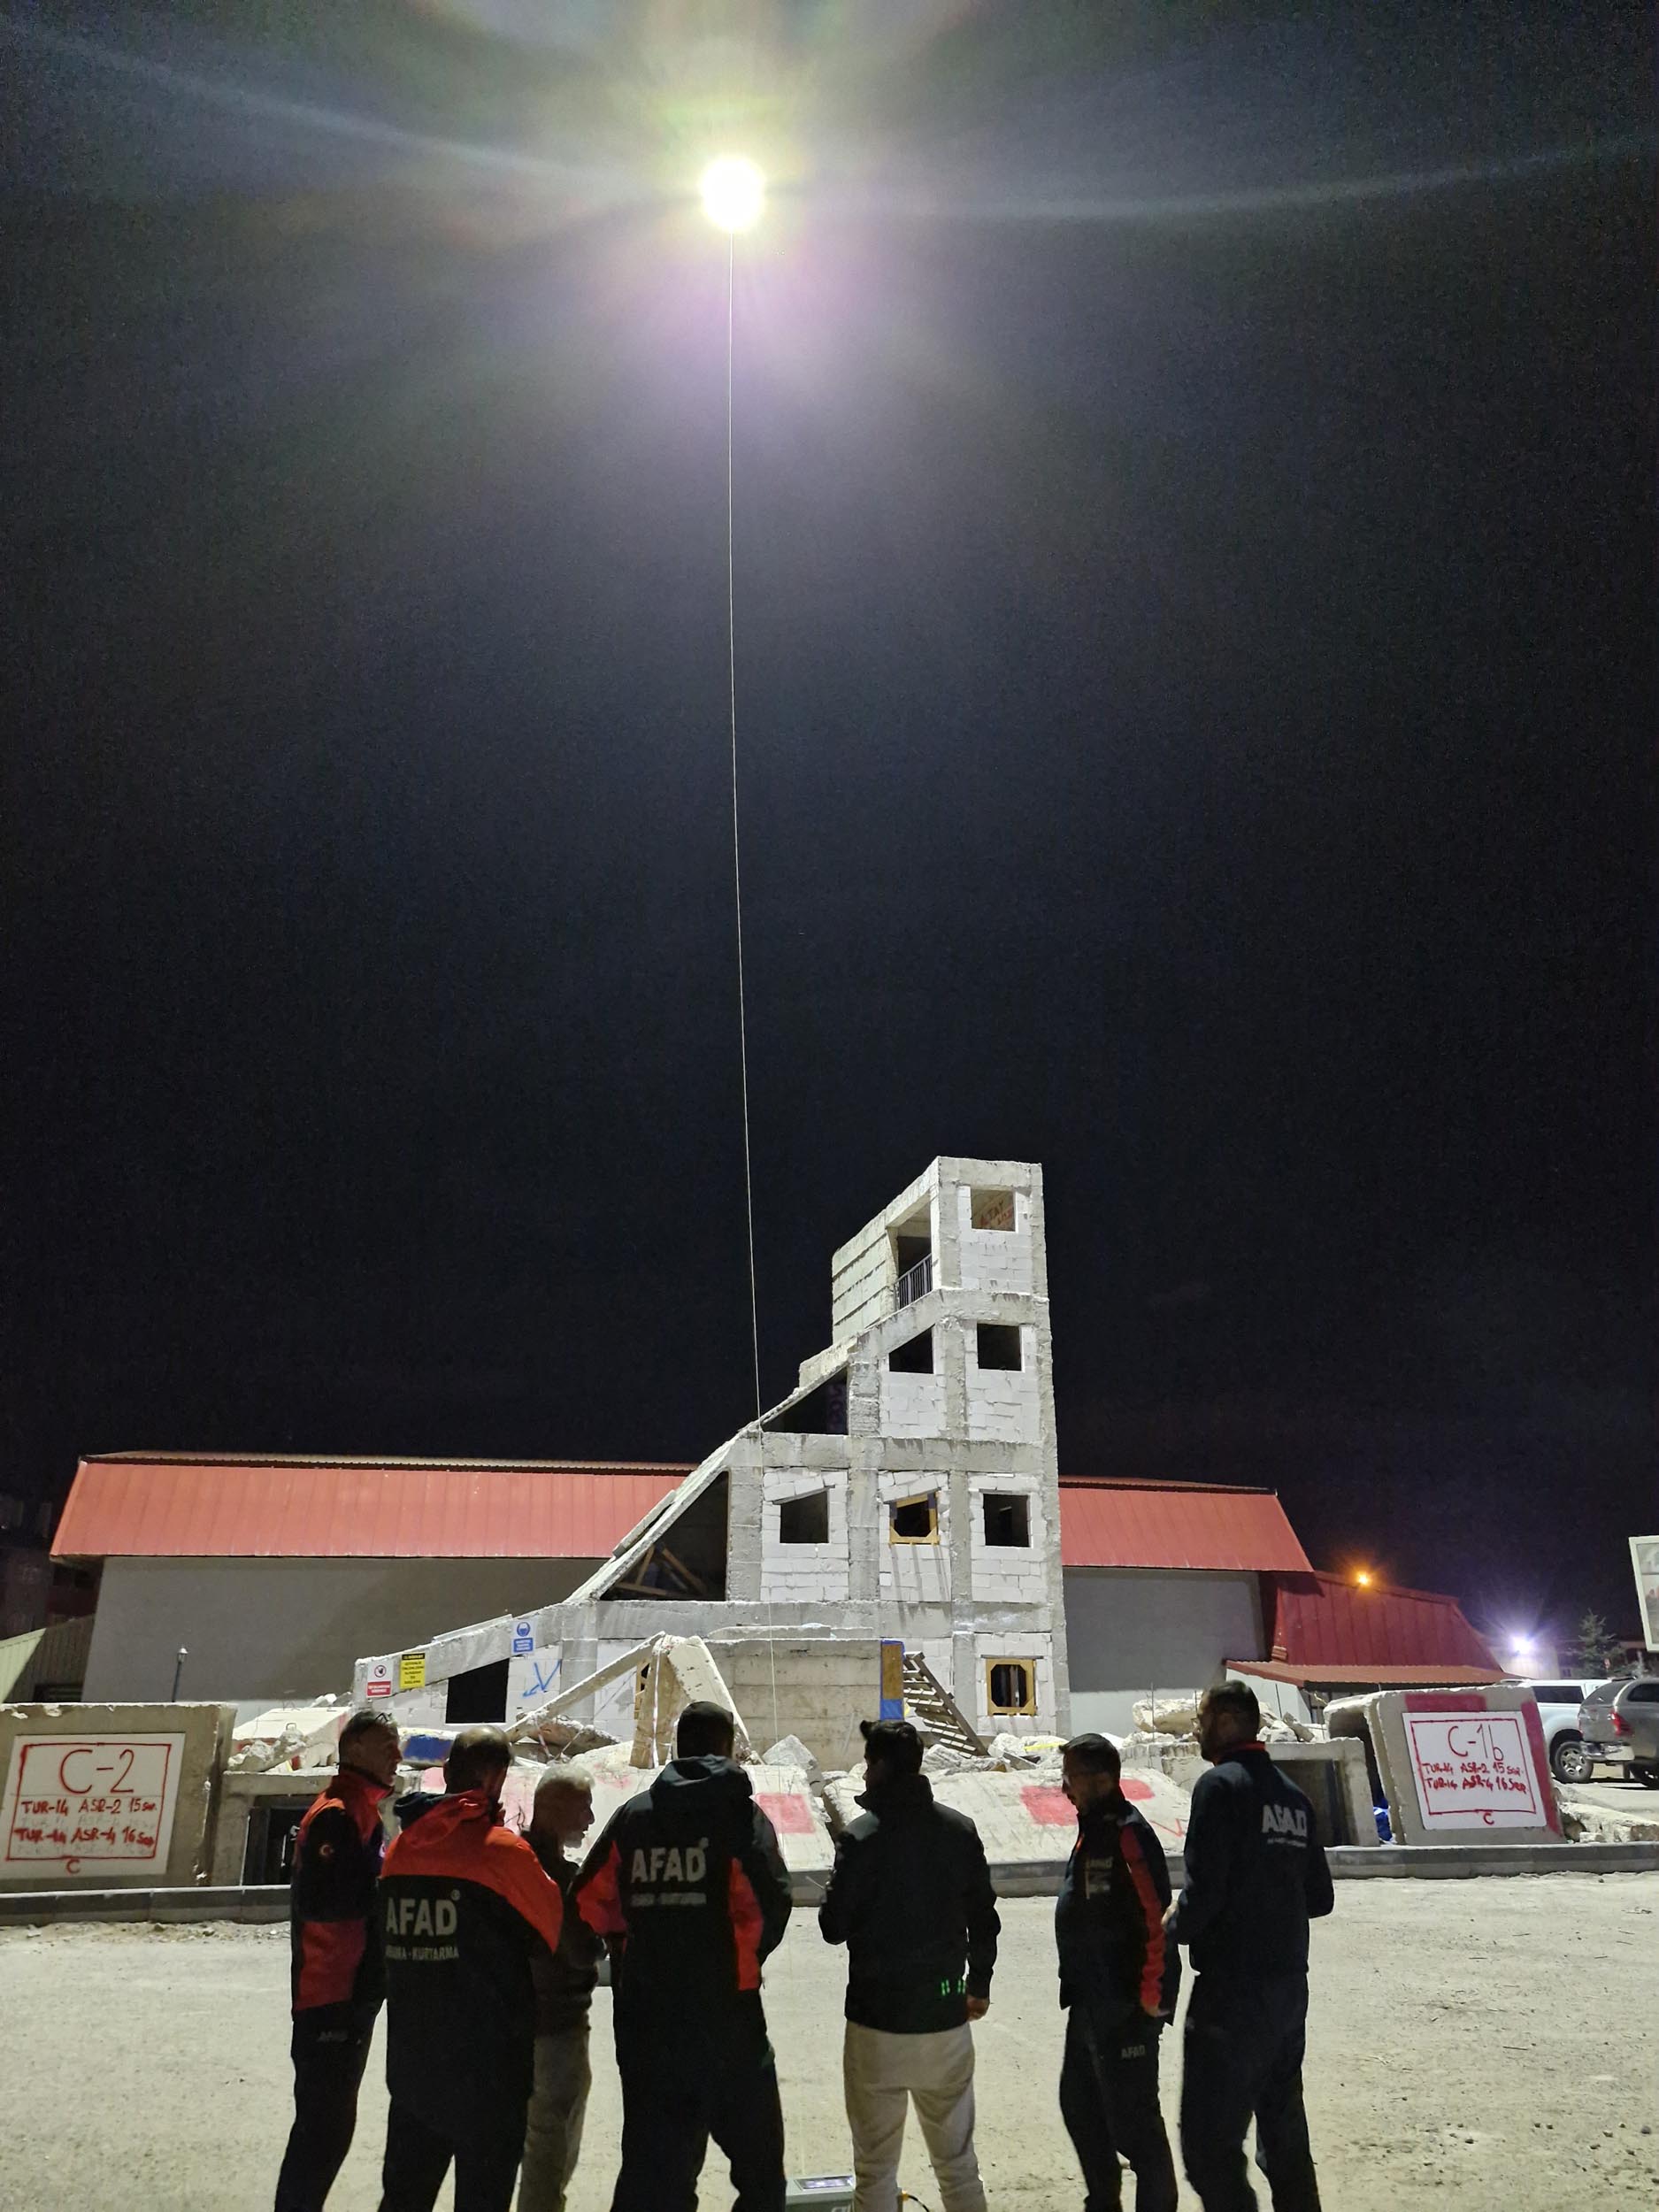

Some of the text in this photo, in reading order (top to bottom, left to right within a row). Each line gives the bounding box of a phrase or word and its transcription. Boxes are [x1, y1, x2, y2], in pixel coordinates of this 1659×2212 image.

[59, 1748, 134, 1794] C-2
[1493, 1762, 1505, 1773] 15
[21, 1799, 69, 1816] TUR-14
[78, 1798, 121, 1814] ASR-2
[129, 1798, 142, 1813] 15
[1483, 1813, 1494, 1825] C
[71, 1826, 116, 1846] ASR-4
[122, 1825, 137, 1843] 16
[65, 1859, 81, 1875] C
[631, 1847, 707, 1884] AFAD
[386, 1896, 457, 1937] AFAD
